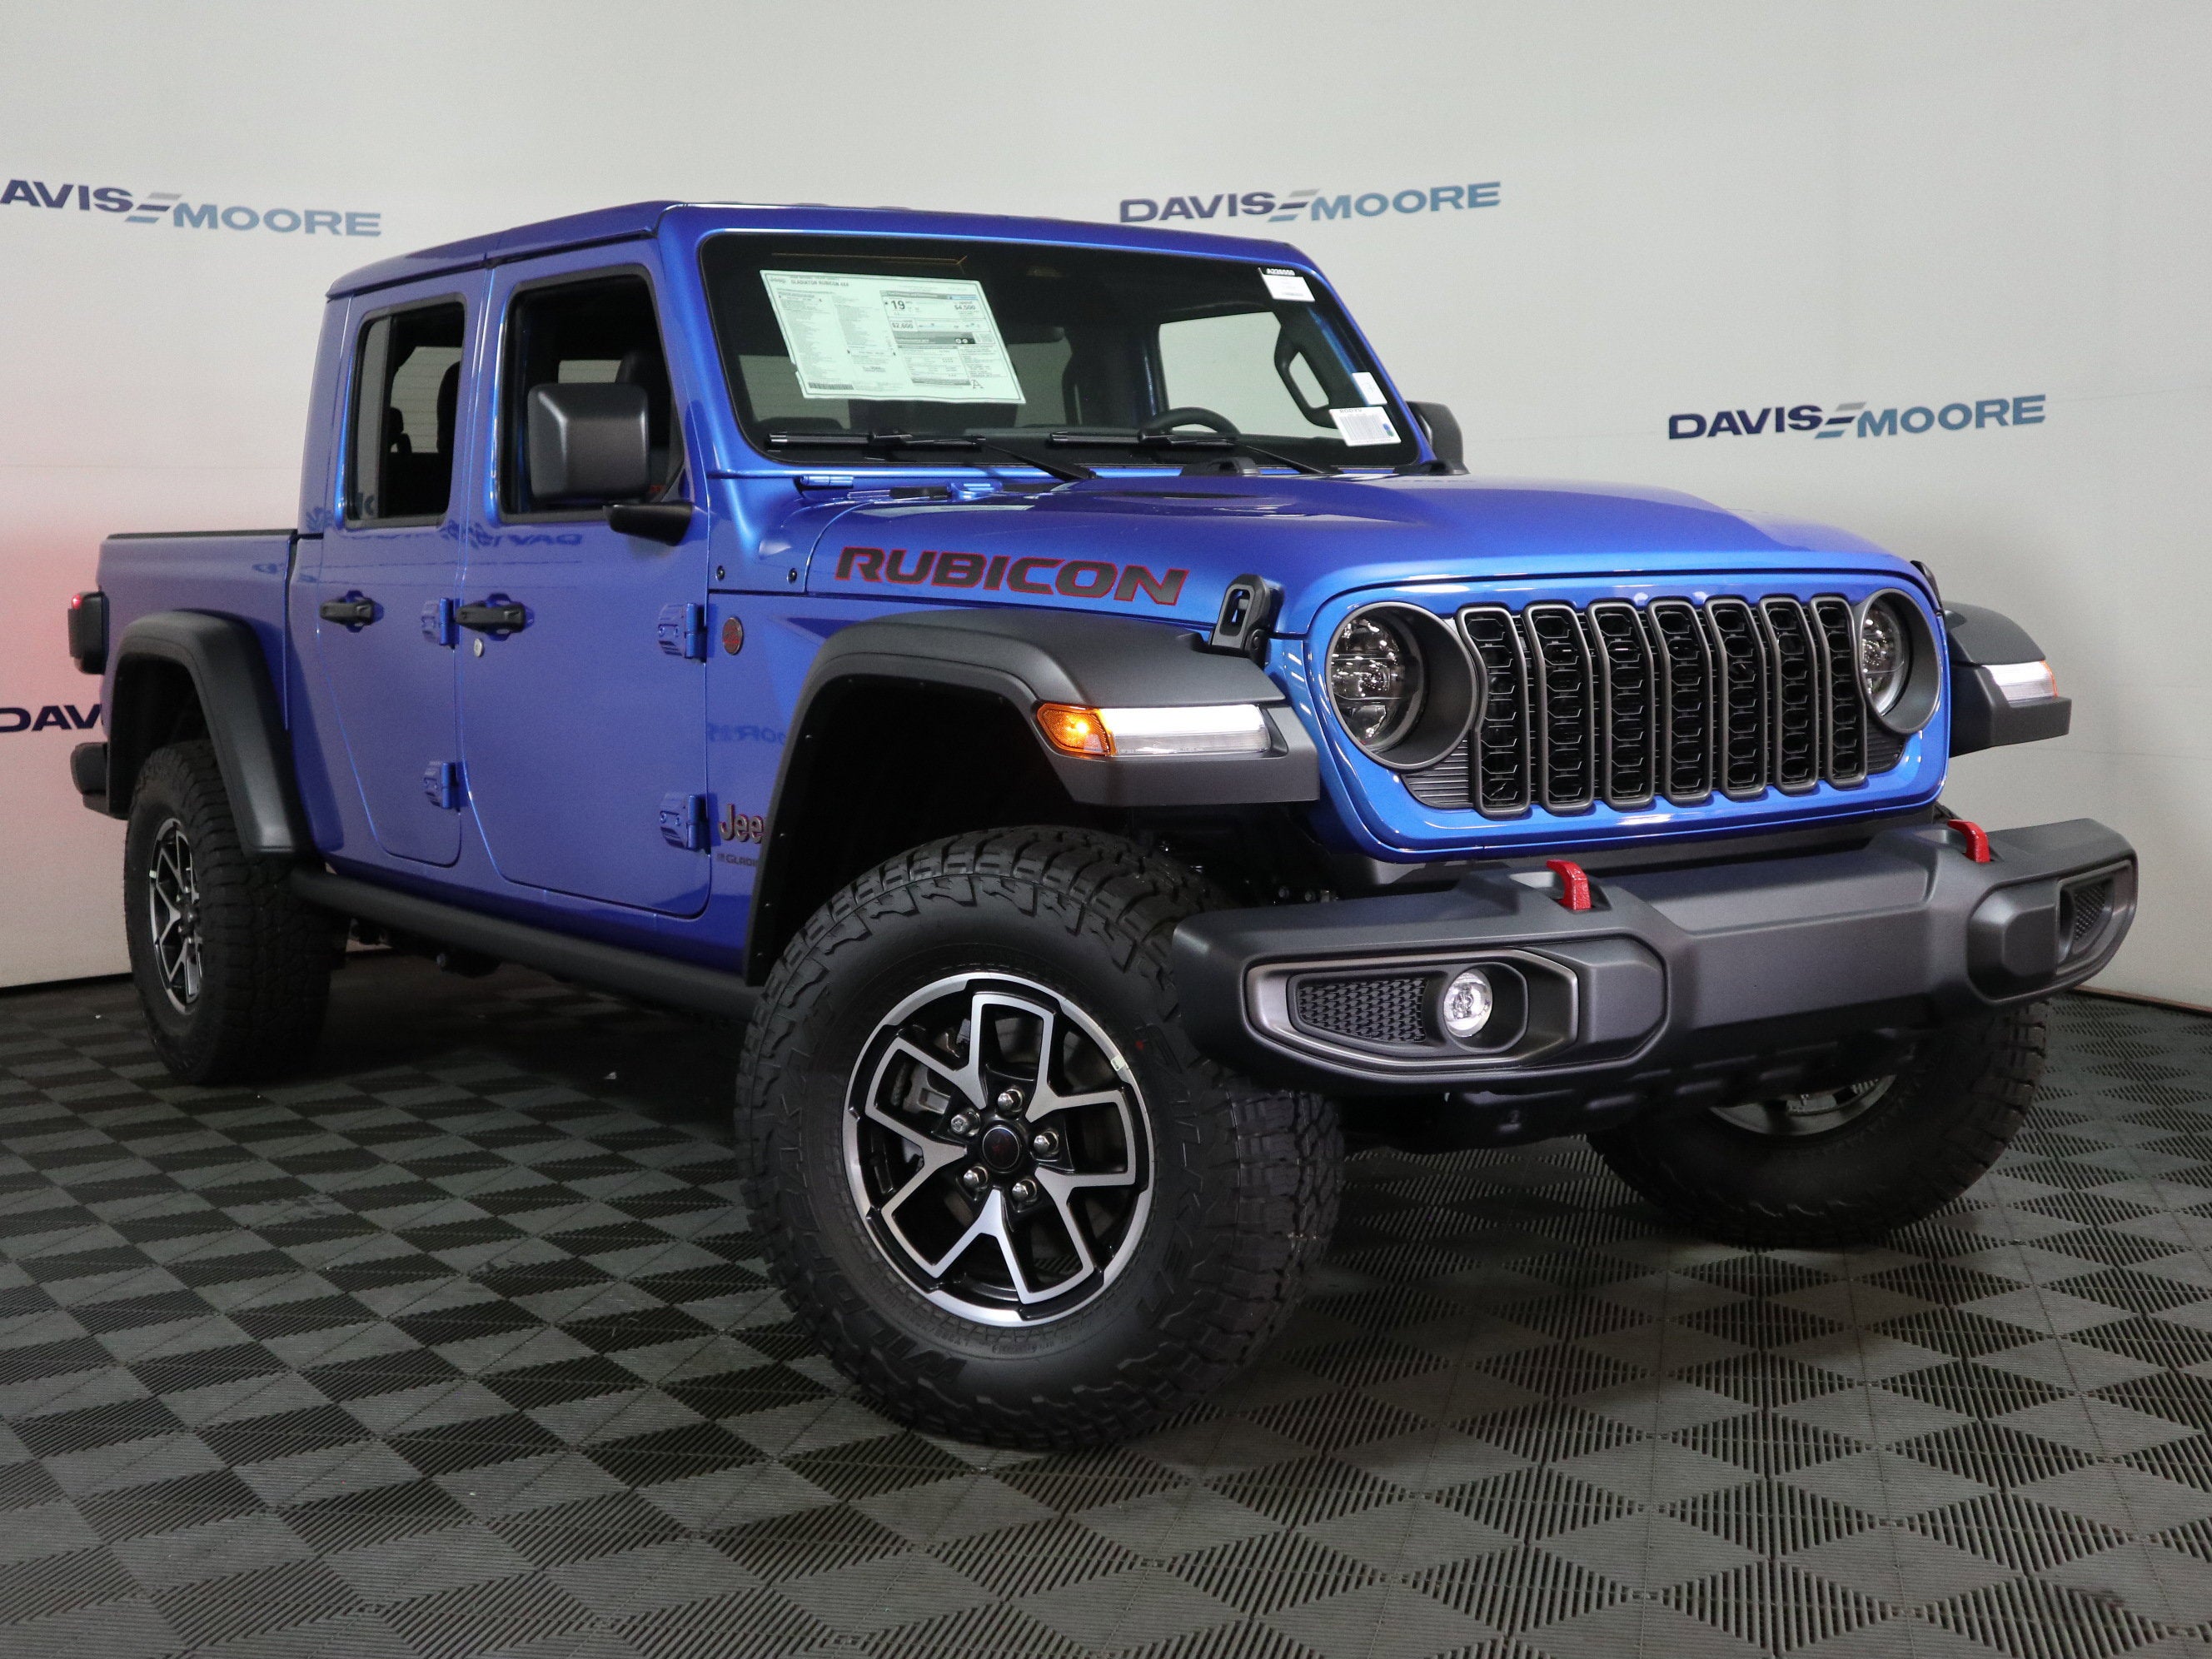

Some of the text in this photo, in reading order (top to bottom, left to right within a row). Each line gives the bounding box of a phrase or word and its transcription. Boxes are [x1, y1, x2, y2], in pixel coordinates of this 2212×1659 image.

[173, 202, 381, 237] MOORE
[1119, 182, 1502, 223] DAVIS MOORE
[890, 300, 906, 311] 19
[1668, 394, 2046, 440] DAVIS MOORE
[834, 546, 1190, 606] RUBICON
